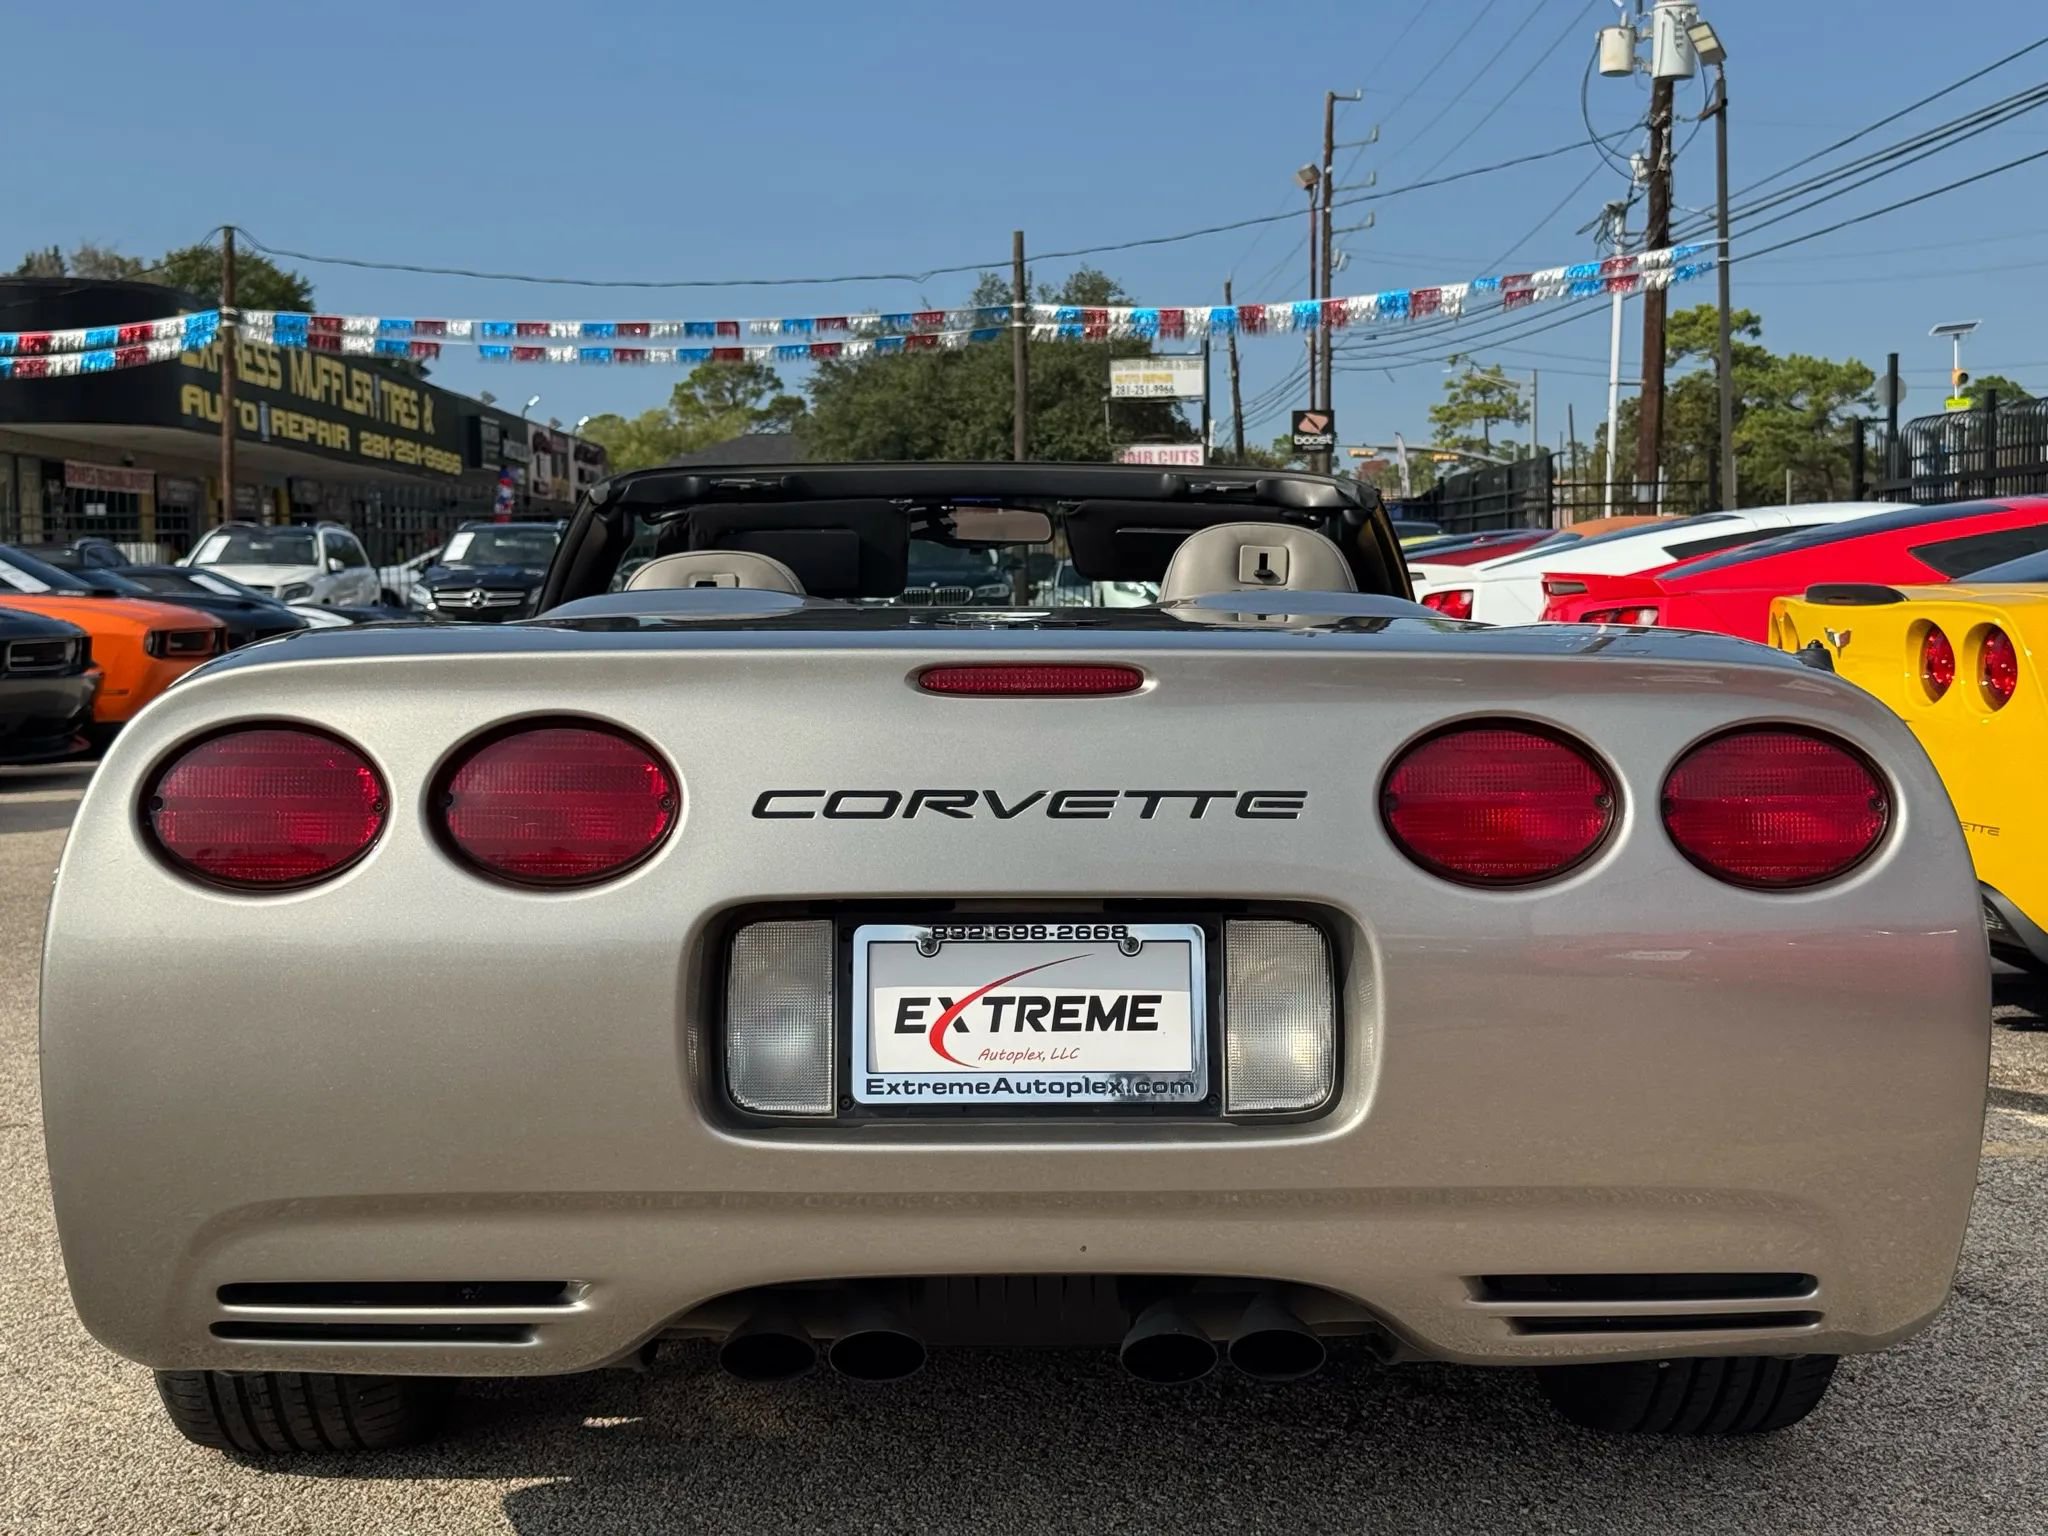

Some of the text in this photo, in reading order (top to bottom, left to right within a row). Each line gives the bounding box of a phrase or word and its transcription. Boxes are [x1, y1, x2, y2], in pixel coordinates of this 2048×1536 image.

[289, 346, 375, 418] MUFFLER
[1115, 385, 1175, 396] 281-251-9966
[270, 407, 350, 450] REPAIR
[1294, 434, 1332, 445] boost
[1158, 449, 1200, 464] CUTS
[751, 789, 1308, 820] CORVETTE
[931, 924, 1129, 940] 832-698-2668
[893, 994, 1163, 1035] EXTREME
[977, 1047, 1081, 1064] Autoplex, LLC
[865, 1077, 1196, 1098] ExtremeAutoplex.com
